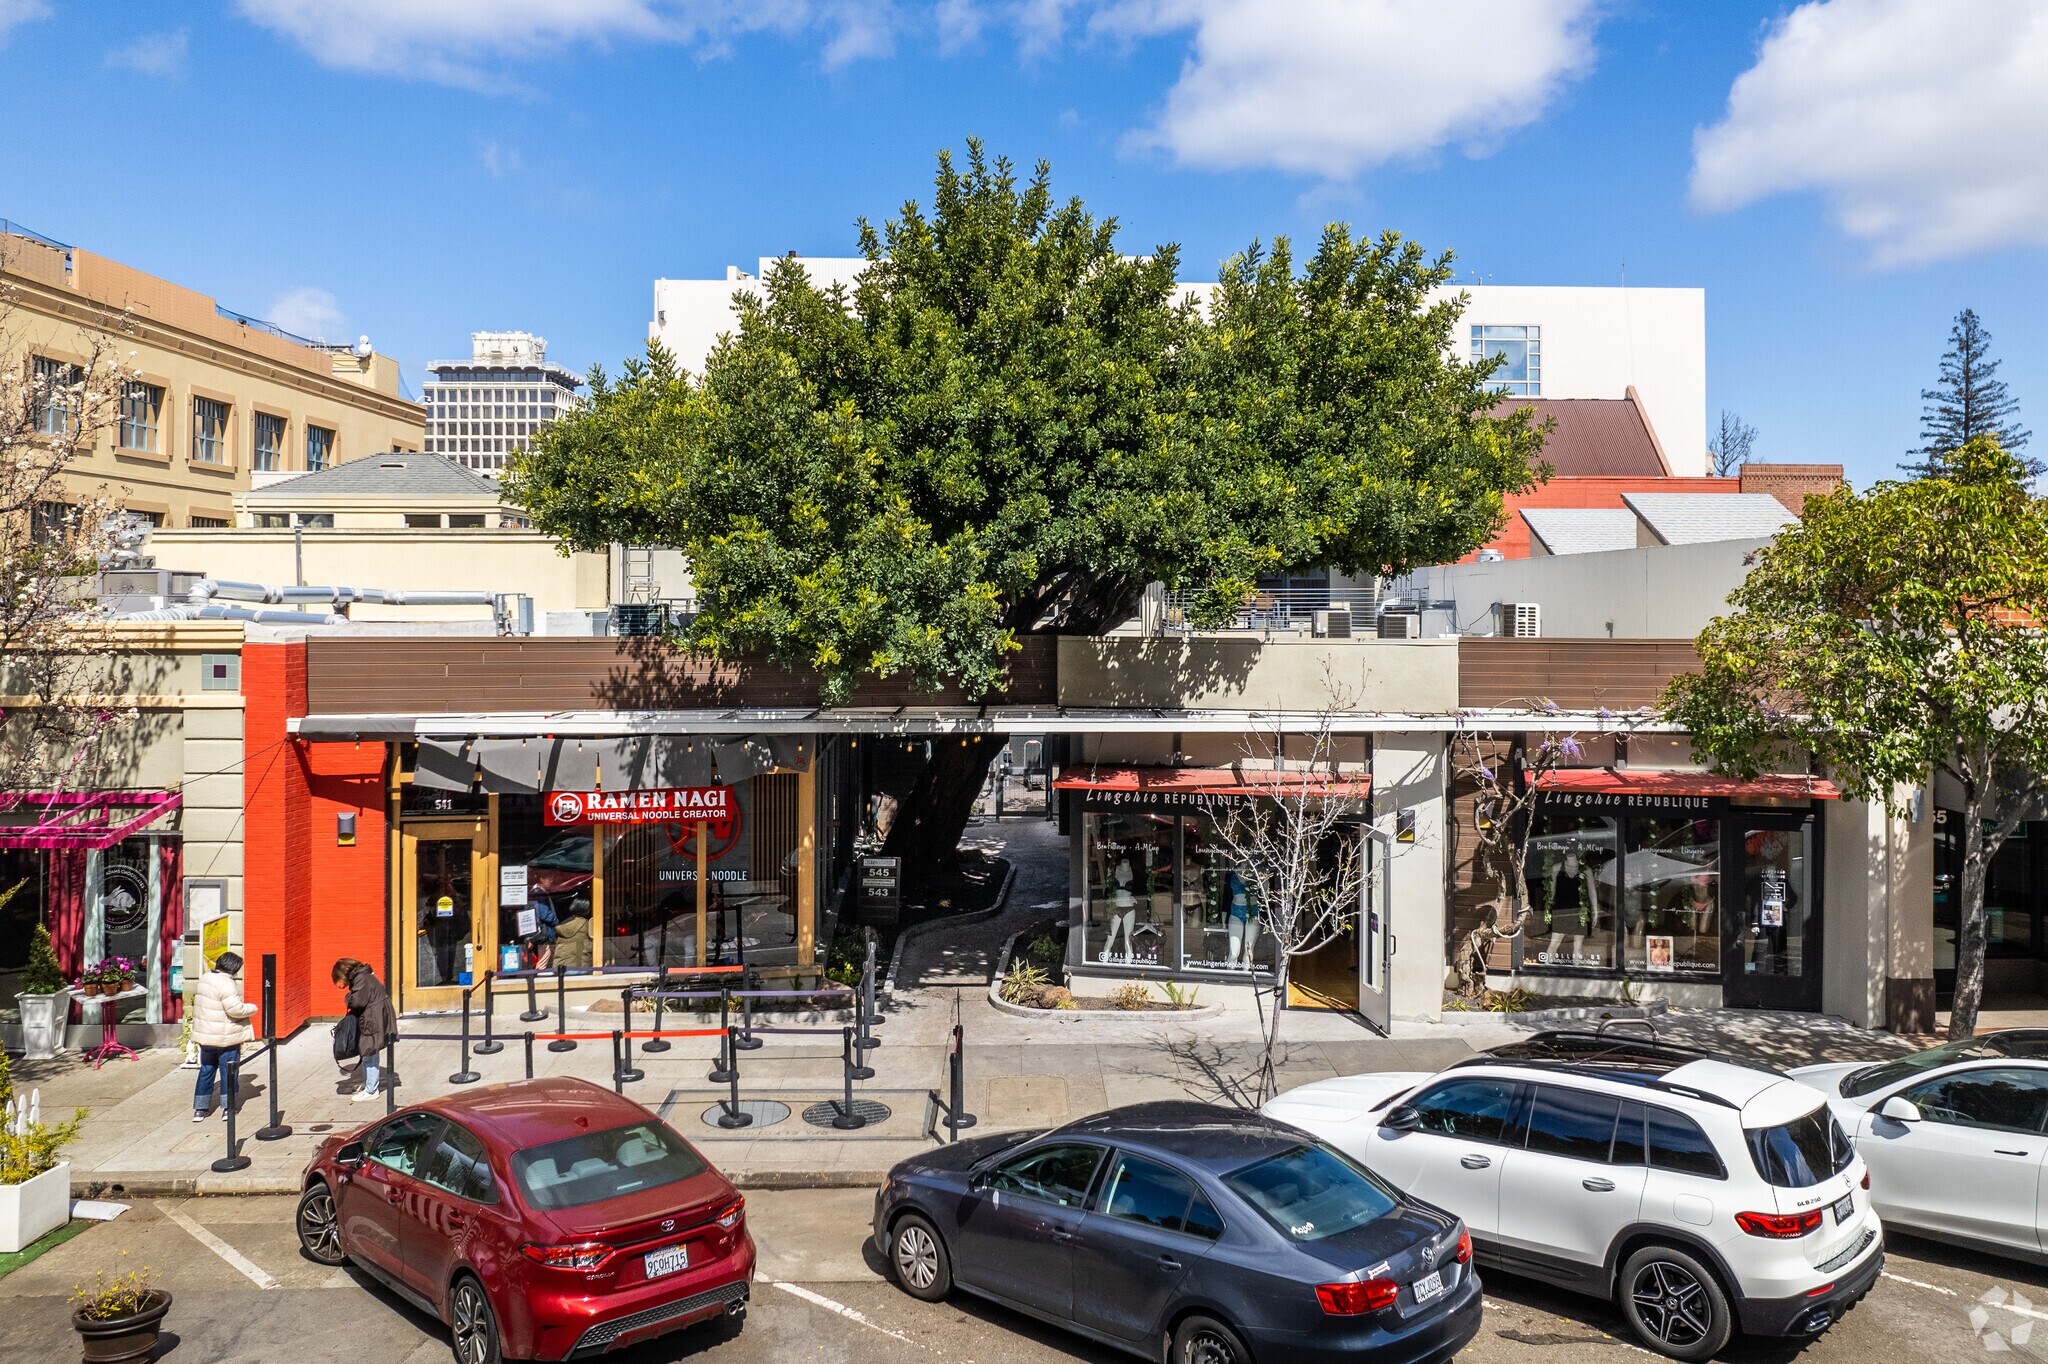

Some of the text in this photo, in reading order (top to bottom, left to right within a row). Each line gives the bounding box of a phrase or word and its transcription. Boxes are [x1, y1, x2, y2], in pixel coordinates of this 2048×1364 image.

[587, 790, 726, 809] RAMEN NAGI
[1086, 788, 1240, 807] Lingerie RÉPUBLIQUE
[1544, 790, 1709, 810] Lingerie RÉPUBLIQUE
[435, 799, 452, 810] 541
[587, 810, 726, 821] UNIVERSAL NOODLE CREATOR
[711, 870, 747, 880] NOODLE
[869, 868, 890, 877] 545
[868, 887, 889, 897] 543
